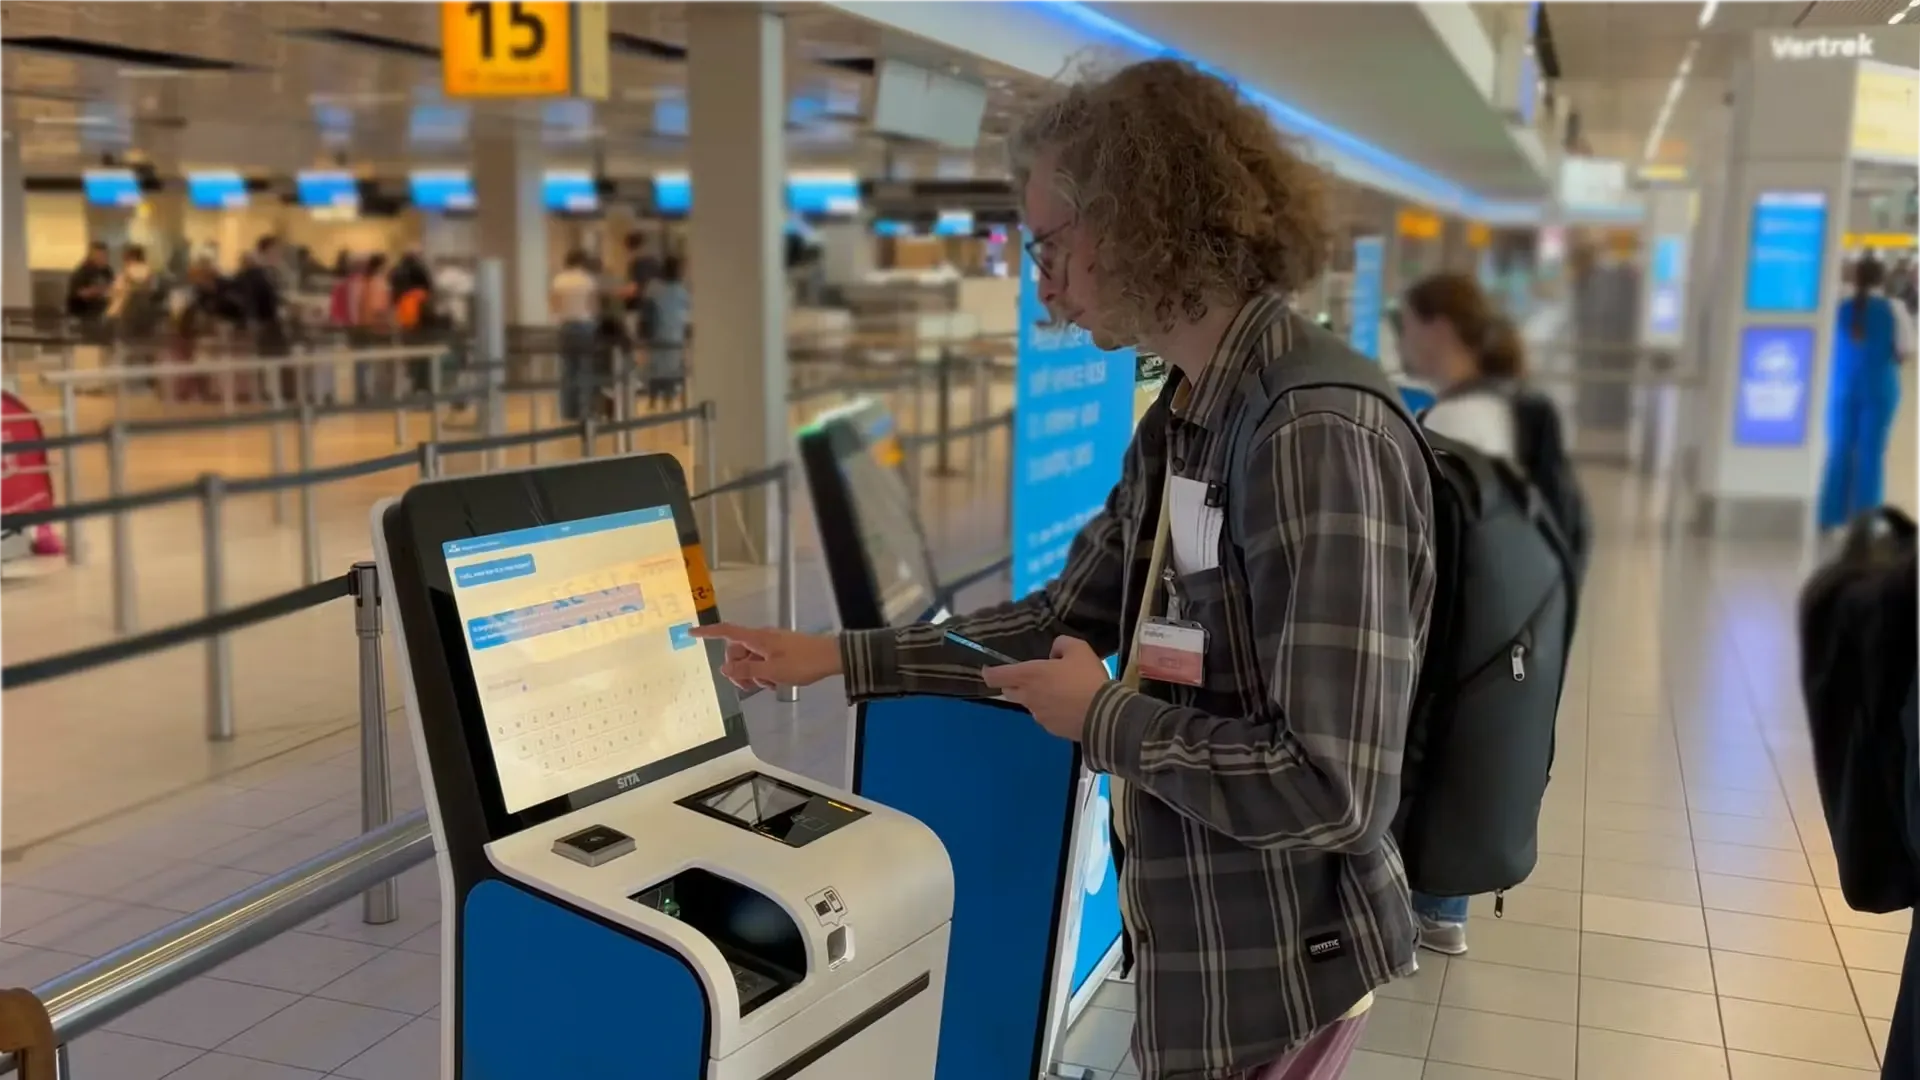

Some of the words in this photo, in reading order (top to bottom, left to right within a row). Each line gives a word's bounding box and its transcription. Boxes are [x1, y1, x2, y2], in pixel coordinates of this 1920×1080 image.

[466, 0, 547, 61] 15
[1770, 33, 1873, 59] Vertrek
[617, 772, 641, 789] SITA
